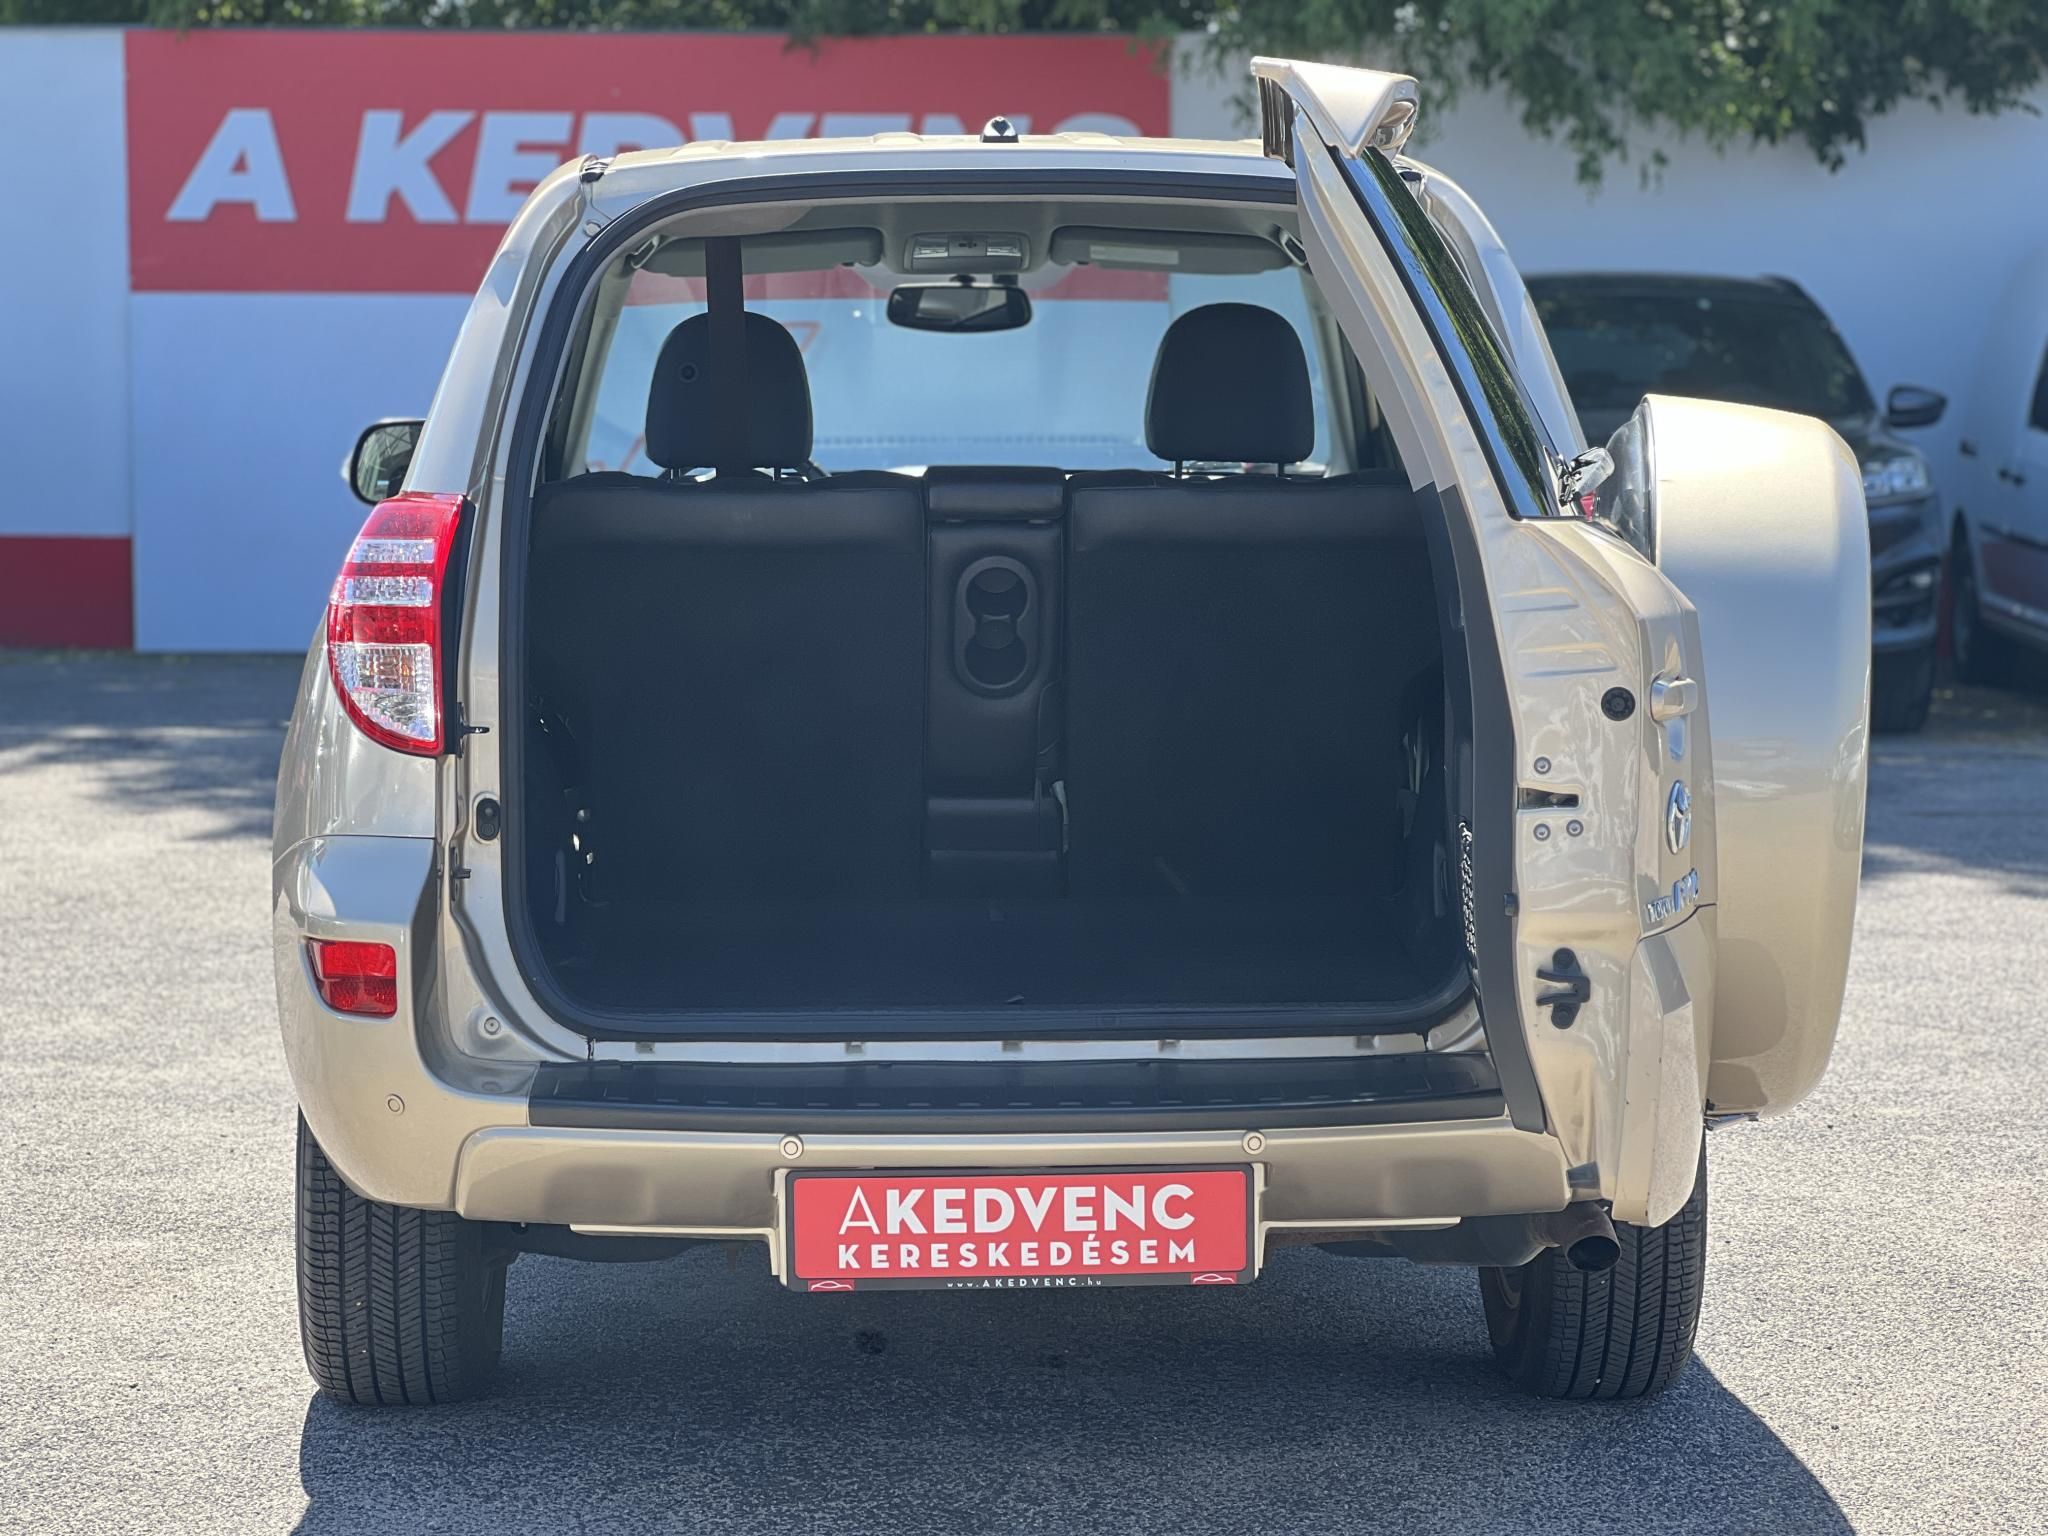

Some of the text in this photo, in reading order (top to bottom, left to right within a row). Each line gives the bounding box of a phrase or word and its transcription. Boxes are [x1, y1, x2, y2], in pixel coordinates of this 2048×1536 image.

[165, 108, 297, 221] A
[838, 1233, 1196, 1269] KERESKEDÉSEM
[947, 1277, 1102, 1288] www.AKEDVENC.hu
